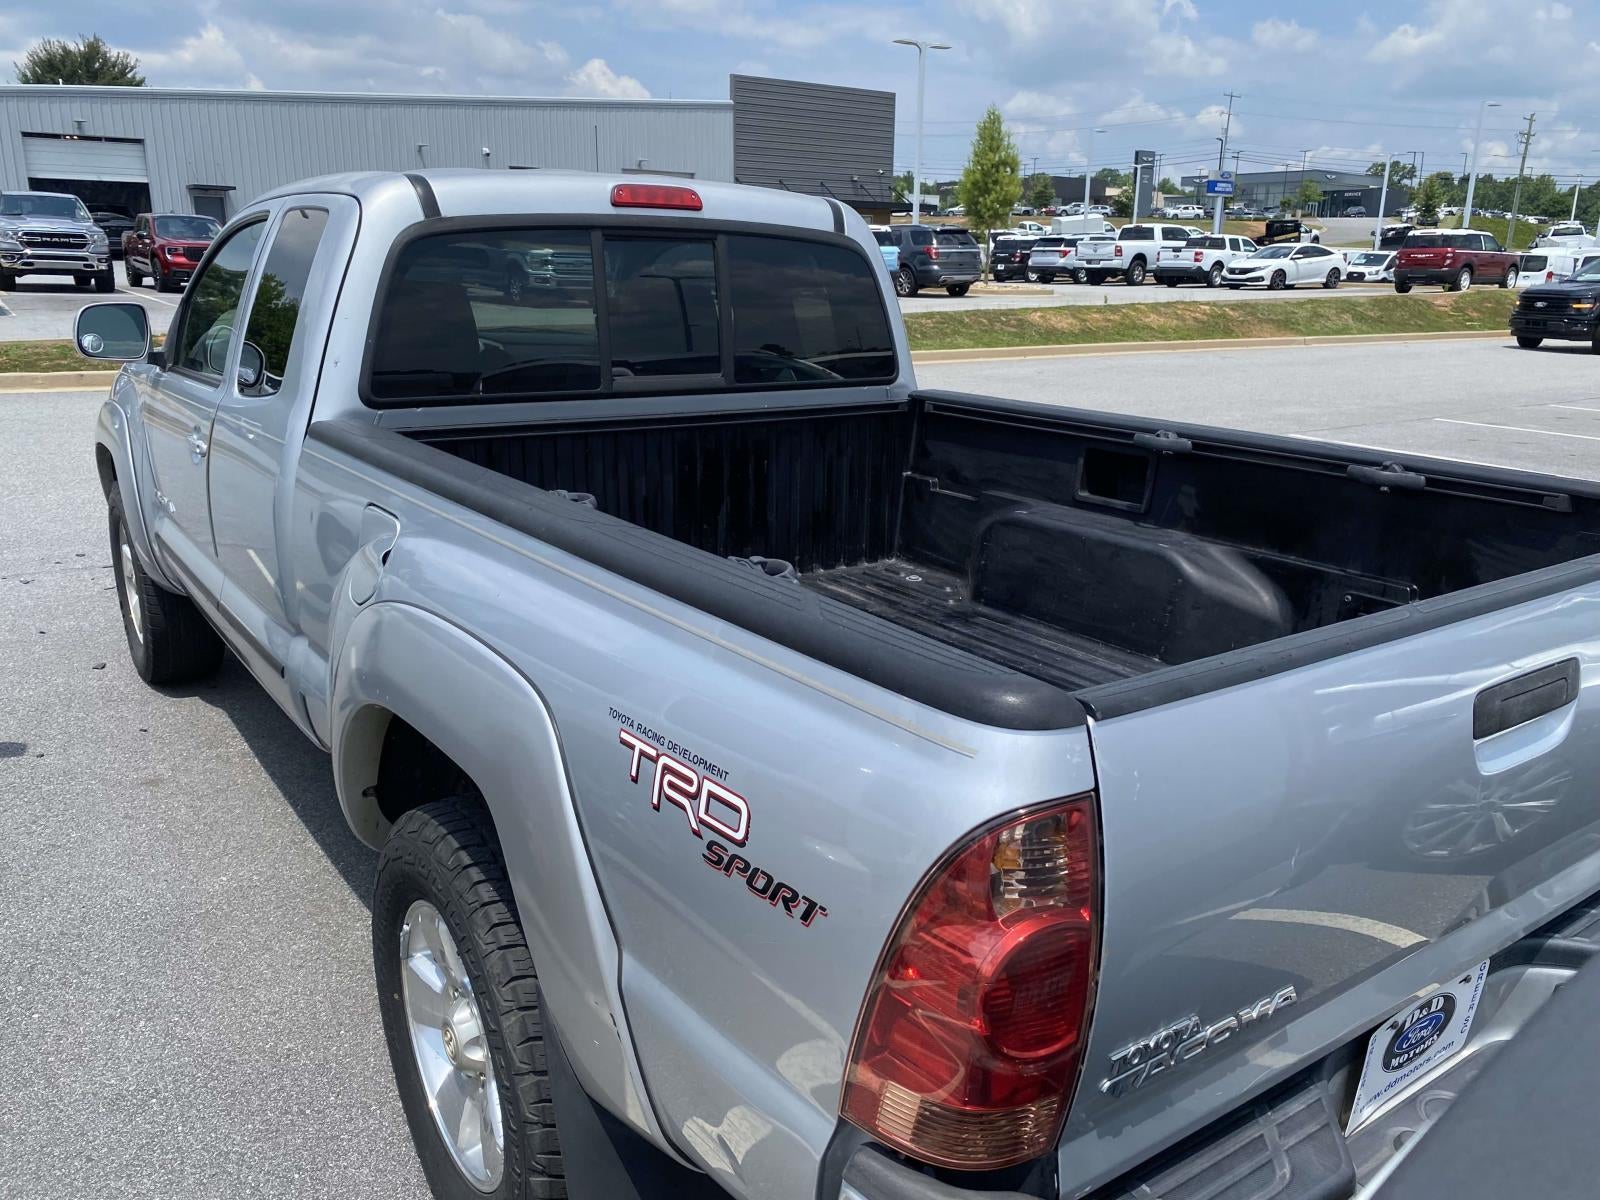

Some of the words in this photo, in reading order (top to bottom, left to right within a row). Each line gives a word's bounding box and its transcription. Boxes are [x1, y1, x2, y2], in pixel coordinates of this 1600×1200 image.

[608, 706, 635, 729] TOYOTA
[636, 723, 666, 747] RACING
[667, 739, 730, 782] DEVELOPMENT
[618, 727, 752, 849] TRD
[701, 839, 829, 928] SPORT
[1403, 996, 1446, 1031] D&D
[1403, 1018, 1436, 1048] Ford
[1389, 1031, 1440, 1071] MOTORS
